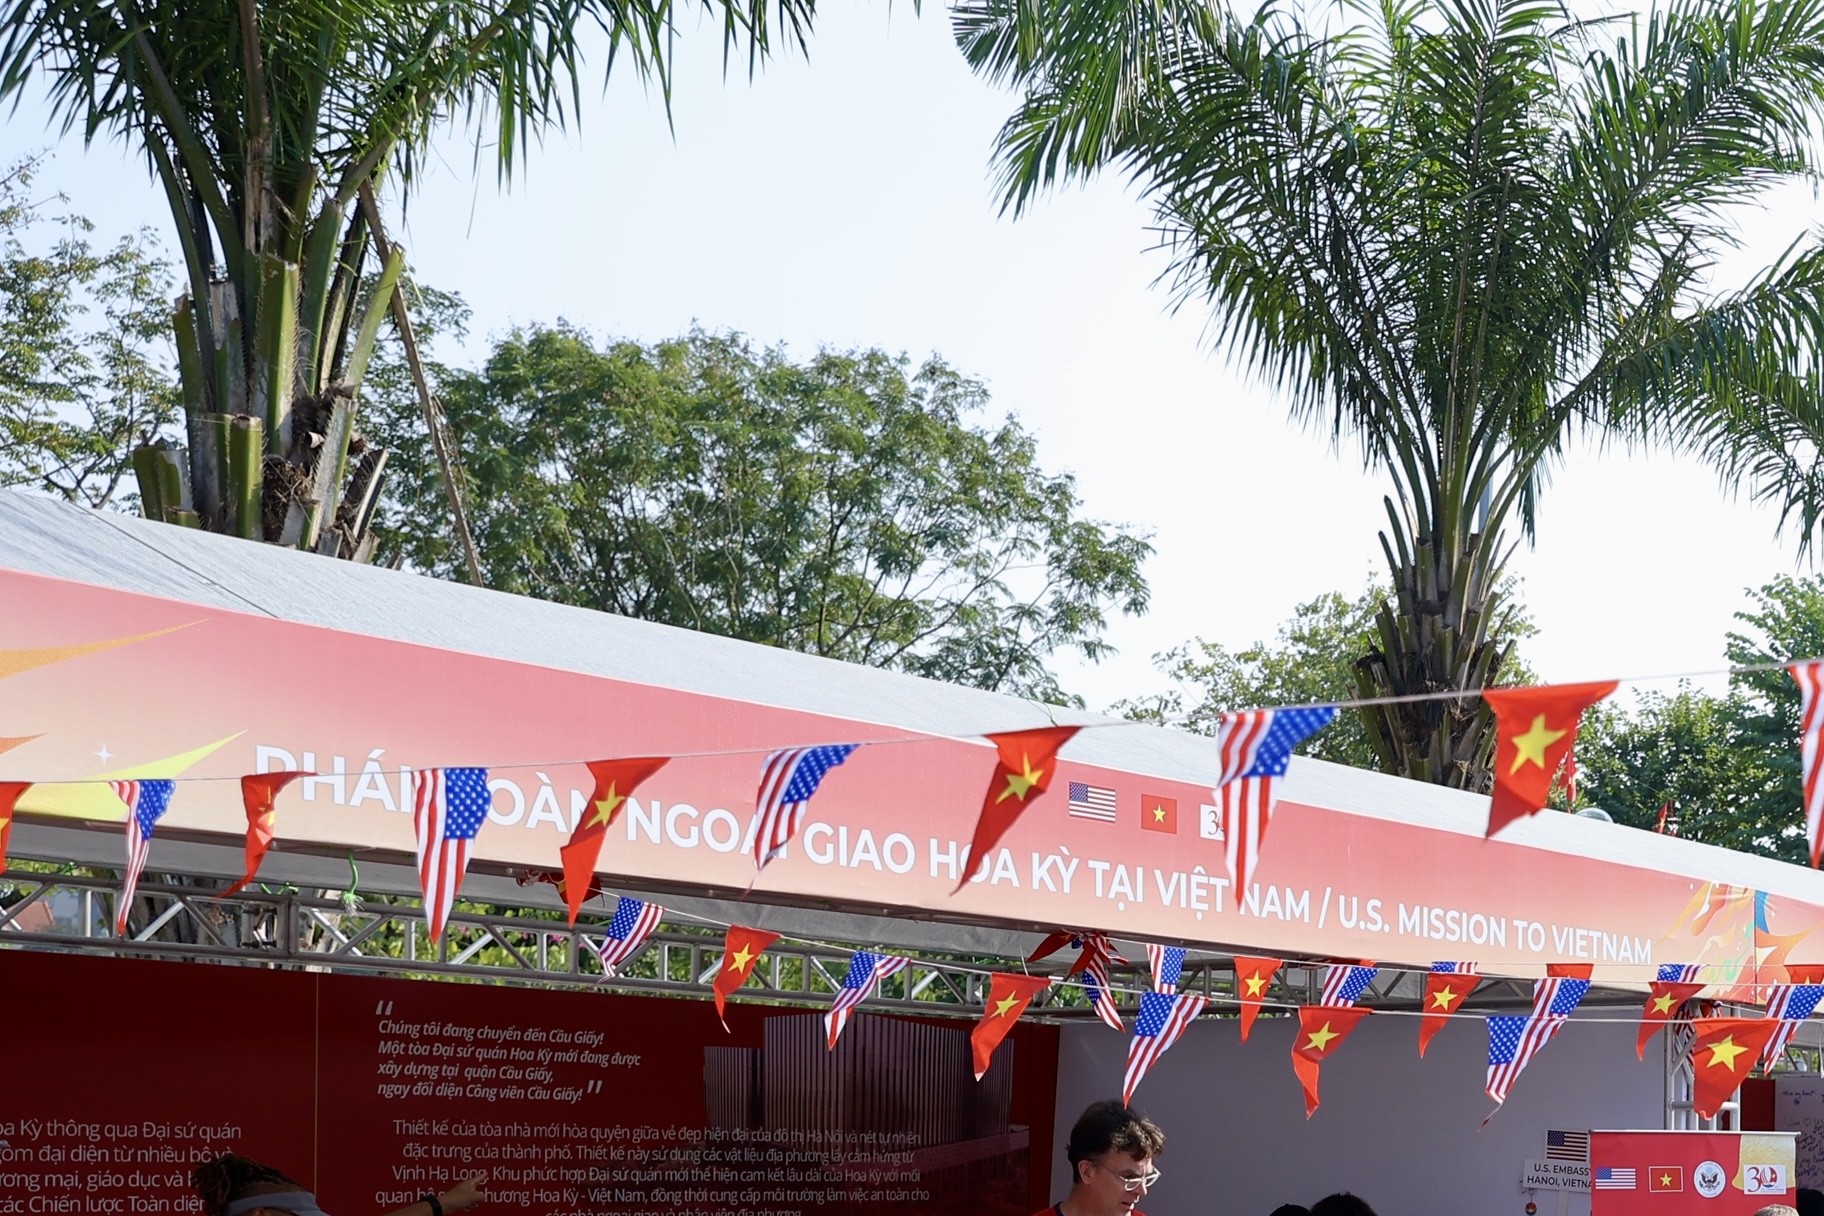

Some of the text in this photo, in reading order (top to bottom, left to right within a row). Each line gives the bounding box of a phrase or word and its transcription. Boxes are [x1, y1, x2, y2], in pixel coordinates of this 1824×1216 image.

[256, 745, 411, 813] PHÁ
[803, 822, 915, 874] GIAO
[929, 838, 1021, 888] HOA
[1031, 845, 1080, 894] KỲ
[1088, 859, 1145, 911] TẠI
[1154, 865, 1229, 921] VIỆT
[1241, 882, 1310, 923] NAM
[1318, 887, 1331, 929] /
[1339, 895, 1389, 933] U.S.
[1399, 903, 1506, 948] MISSION
[1513, 919, 1546, 952] TO
[1552, 925, 1652, 965] VIETNAM
[379, 1020, 604, 1048] Chúng tôi đang chuyển đến Cầu Giấy!
[378, 1041, 641, 1067] Một tòa Đại sứ quán Hoa Kỳ mới đang được
[378, 1061, 554, 1083] xây dựng tại quận Cầu Giấy,
[378, 1082, 583, 1104] ngay đối diện Công viên Cầu Giấy!
[20, 1119, 241, 1143] Kỳ thông qua Đại sứ quán
[393, 1119, 920, 1146] Thiết kế của tòa nhà mới hòa quyện giữa vẻ đẹp hiện đại của đô thị Hà Nội và nét tự nhiên
[1534, 1164, 1551, 1173] U.S.
[1527, 1175, 1591, 1187] HANOI, VIETNA
